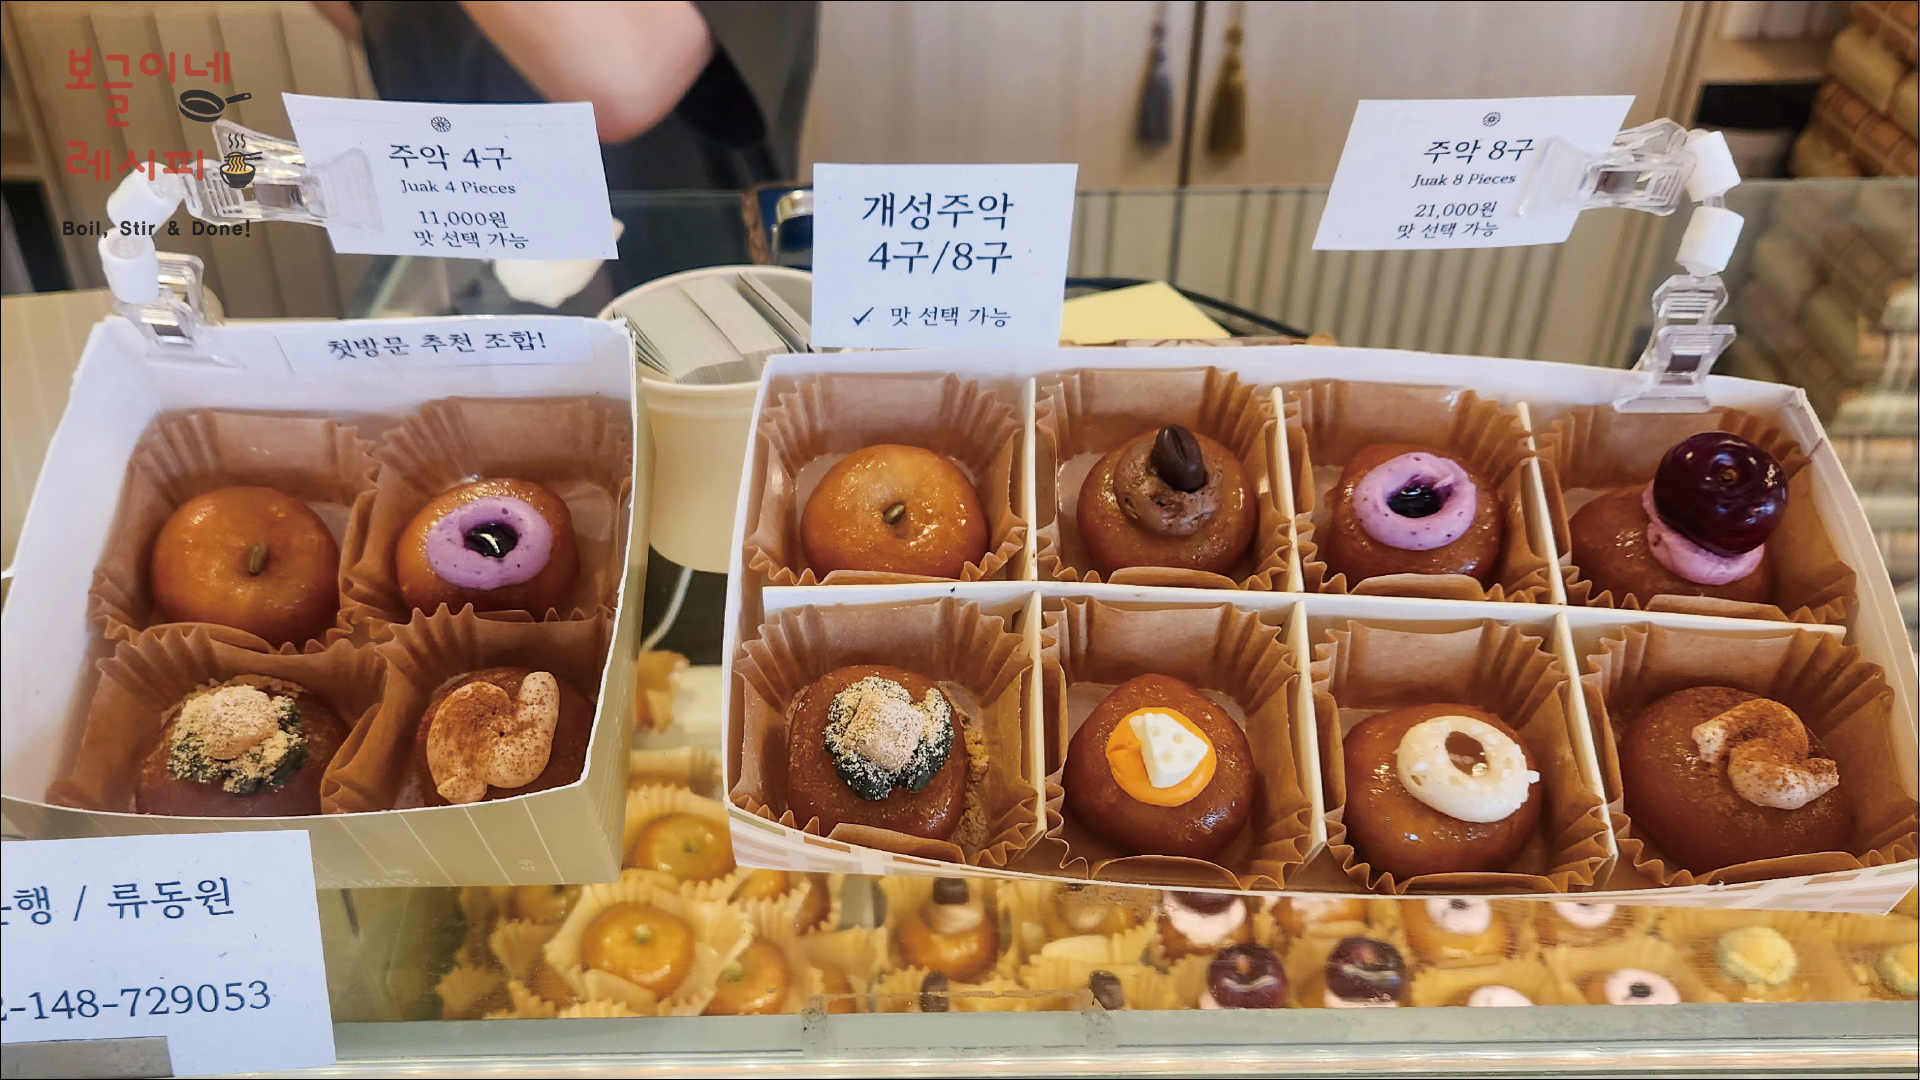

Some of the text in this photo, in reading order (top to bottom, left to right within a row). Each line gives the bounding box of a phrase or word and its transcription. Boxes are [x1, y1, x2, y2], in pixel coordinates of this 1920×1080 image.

[388, 144, 512, 172] 주악 4구
[1423, 138, 1534, 165] 주악 8구
[400, 179, 516, 194] Juak 4 Pieces
[1410, 173, 1517, 189] Juak 8 Pieces
[418, 210, 509, 229] 11,000원
[861, 191, 1014, 231] 개성주악
[1414, 200, 1498, 220] 21,000원
[413, 229, 529, 250] 맛 선택 가능
[1397, 221, 1499, 240] 맛 선택 가능
[867, 240, 1013, 275] 4구/8구
[890, 305, 1011, 328] 맛 선택 가능
[327, 330, 546, 360] 첫방문 추천 조합!
[72, 884, 88, 922] /
[107, 876, 235, 920] 류동원
